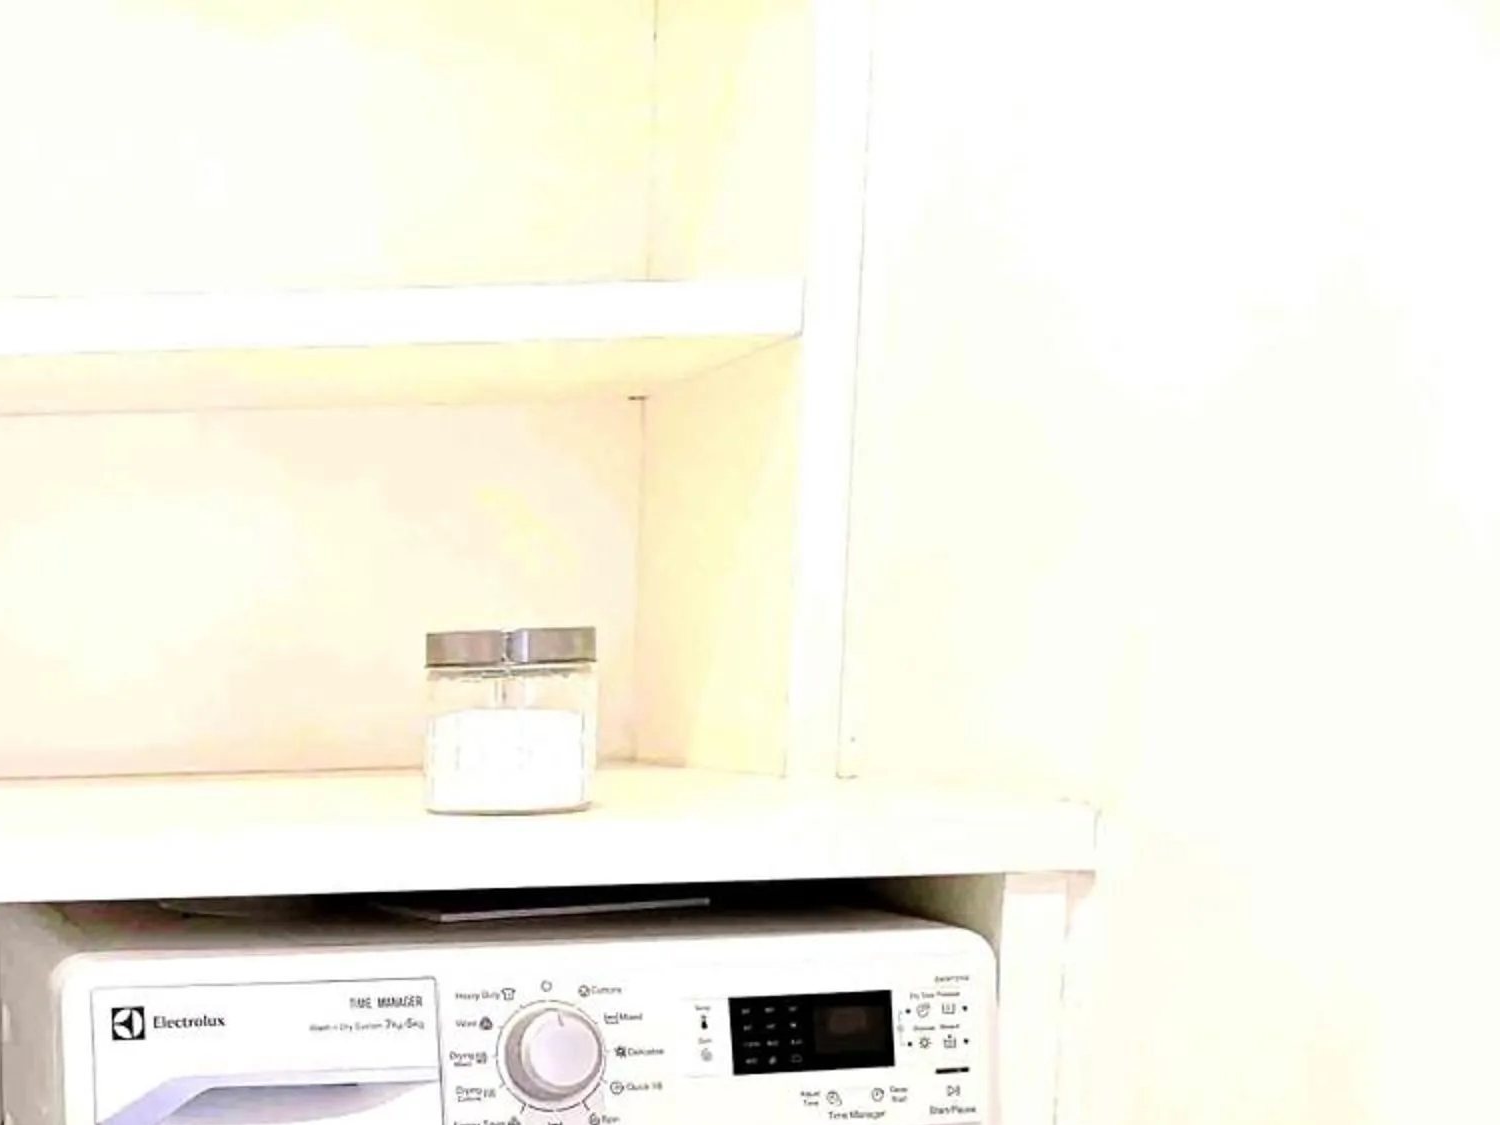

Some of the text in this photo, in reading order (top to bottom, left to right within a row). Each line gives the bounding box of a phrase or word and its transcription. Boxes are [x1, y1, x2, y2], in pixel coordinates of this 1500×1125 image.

[349, 994, 423, 1009] TIME MANAGER
[153, 1015, 226, 1029] Electrolux
